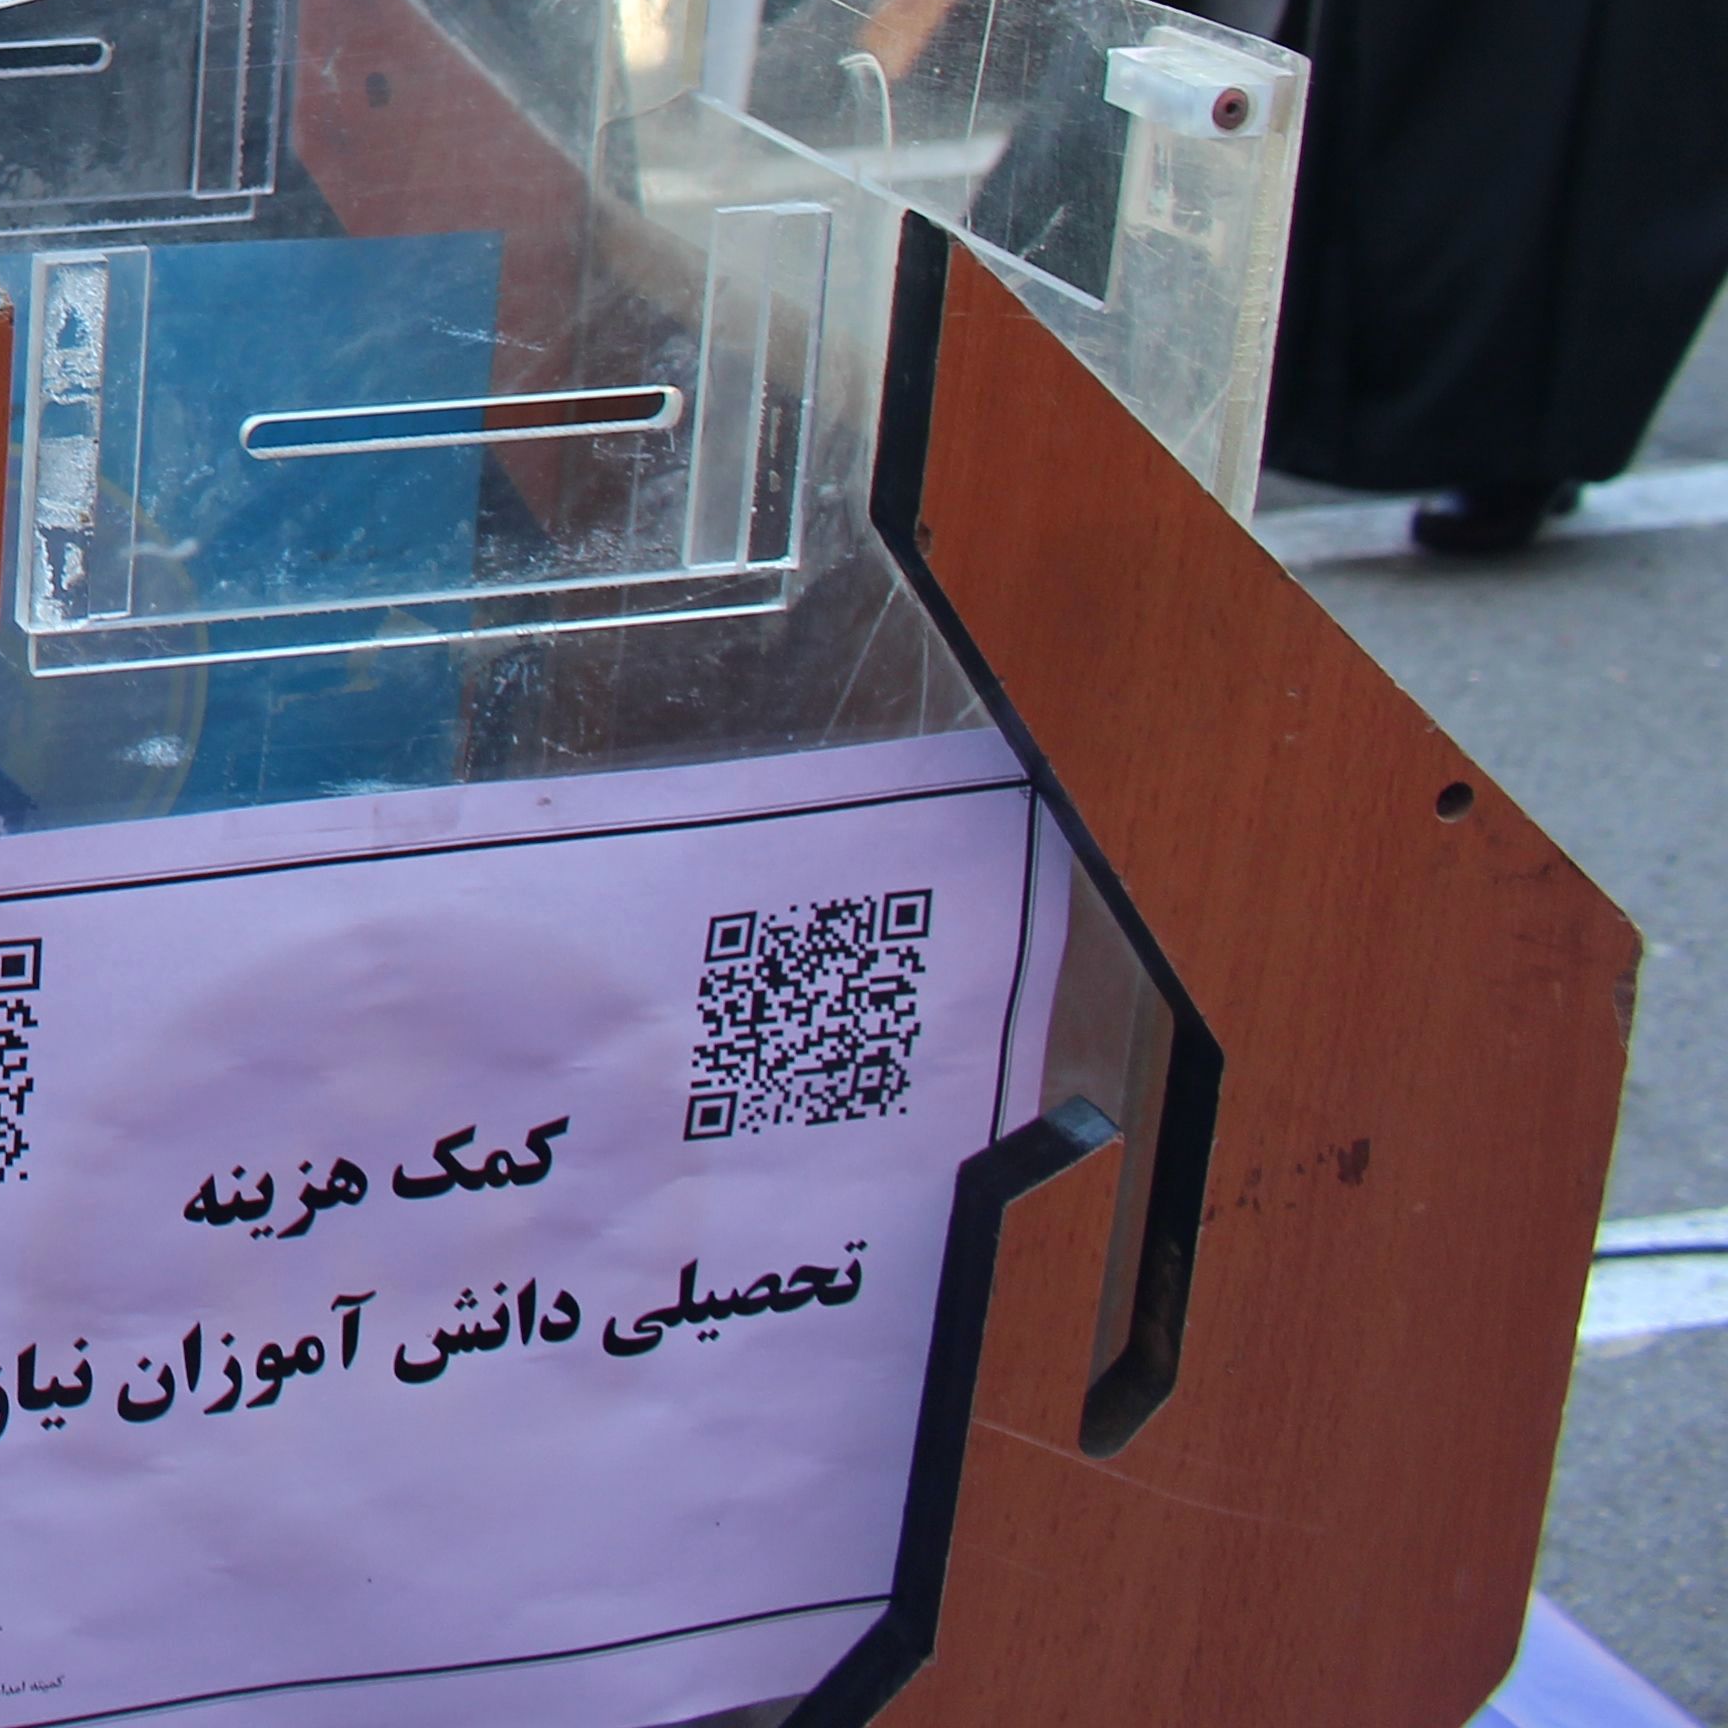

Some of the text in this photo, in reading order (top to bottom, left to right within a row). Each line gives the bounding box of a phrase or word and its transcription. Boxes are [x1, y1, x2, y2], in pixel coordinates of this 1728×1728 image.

[183, 1115, 570, 1241] کمک هزینه
[117, 1290, 377, 1424] آموزان
[393, 1277, 581, 1385] دانش
[602, 1239, 868, 1358] تحصیلی
[29, 1674, 66, 1694] کمیته
